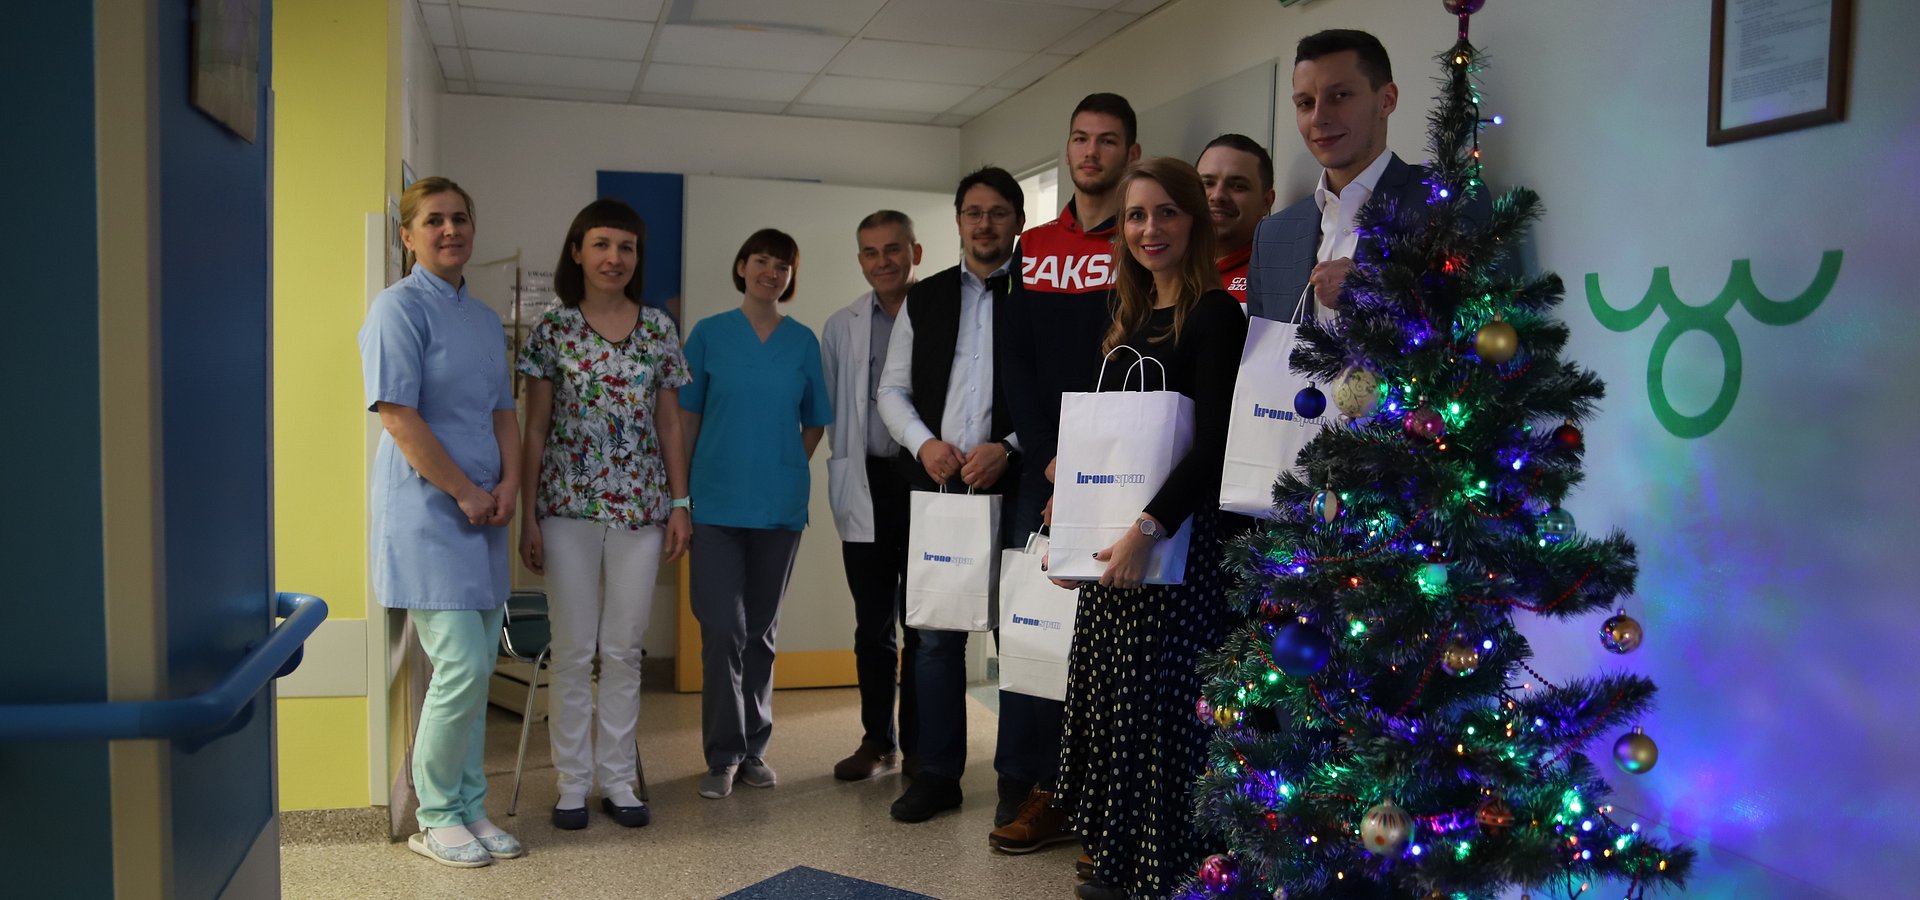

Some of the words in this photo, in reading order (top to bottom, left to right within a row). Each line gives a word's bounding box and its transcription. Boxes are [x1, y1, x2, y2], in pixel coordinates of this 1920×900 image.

[1076, 471, 1146, 487] kronospan
[923, 552, 975, 566] kronospan
[1012, 613, 1062, 630] kronospan
